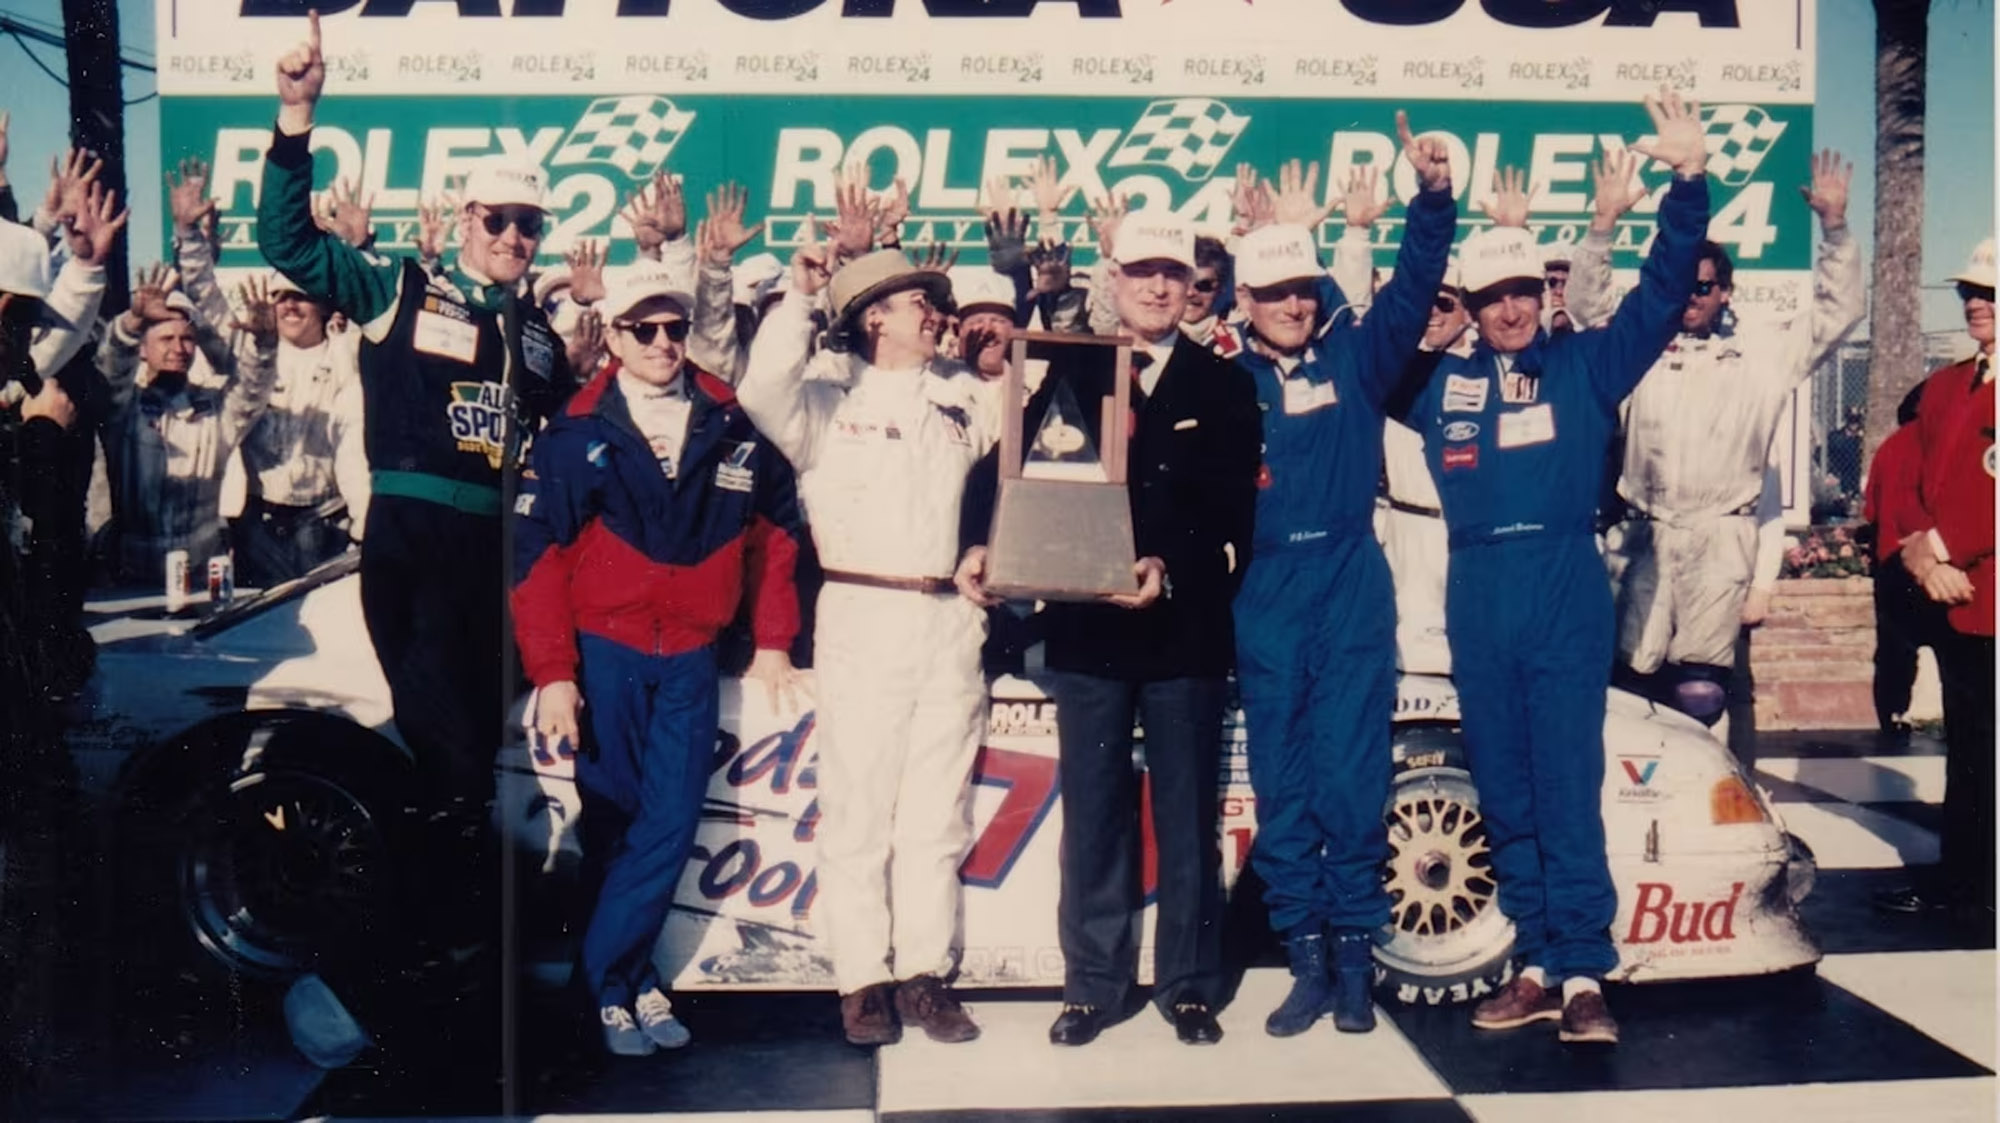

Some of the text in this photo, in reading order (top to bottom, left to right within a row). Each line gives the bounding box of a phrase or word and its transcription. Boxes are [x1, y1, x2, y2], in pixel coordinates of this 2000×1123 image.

[171, 56, 254, 81] ROLEX 24
[346, 67, 368, 81] 24
[400, 56, 481, 81] ROLEX 24
[512, 55, 595, 81] ROLEX 24
[625, 56, 707, 81] ROLEX 24
[736, 56, 818, 81] ROLEX 24
[848, 56, 930, 82] ROLEX 24
[961, 56, 1041, 82] ROLEX 24
[1072, 57, 1153, 83] ROLEX 24
[1184, 58, 1264, 84] ROLEX 24
[1296, 59, 1377, 85] ROLEX 24
[1403, 61, 1483, 87] ROLEX 24
[1509, 63, 1590, 88] ROLEX 24
[1616, 63, 1696, 89] ROLEX 24
[1721, 65, 1801, 91] ROLEX 24
[771, 125, 1121, 210] ROLEX
[1322, 130, 1664, 213] ROLEX
[453, 406, 501, 444] SPO
[991, 703, 1058, 728] ROLE
[1622, 881, 1745, 945] Bud
